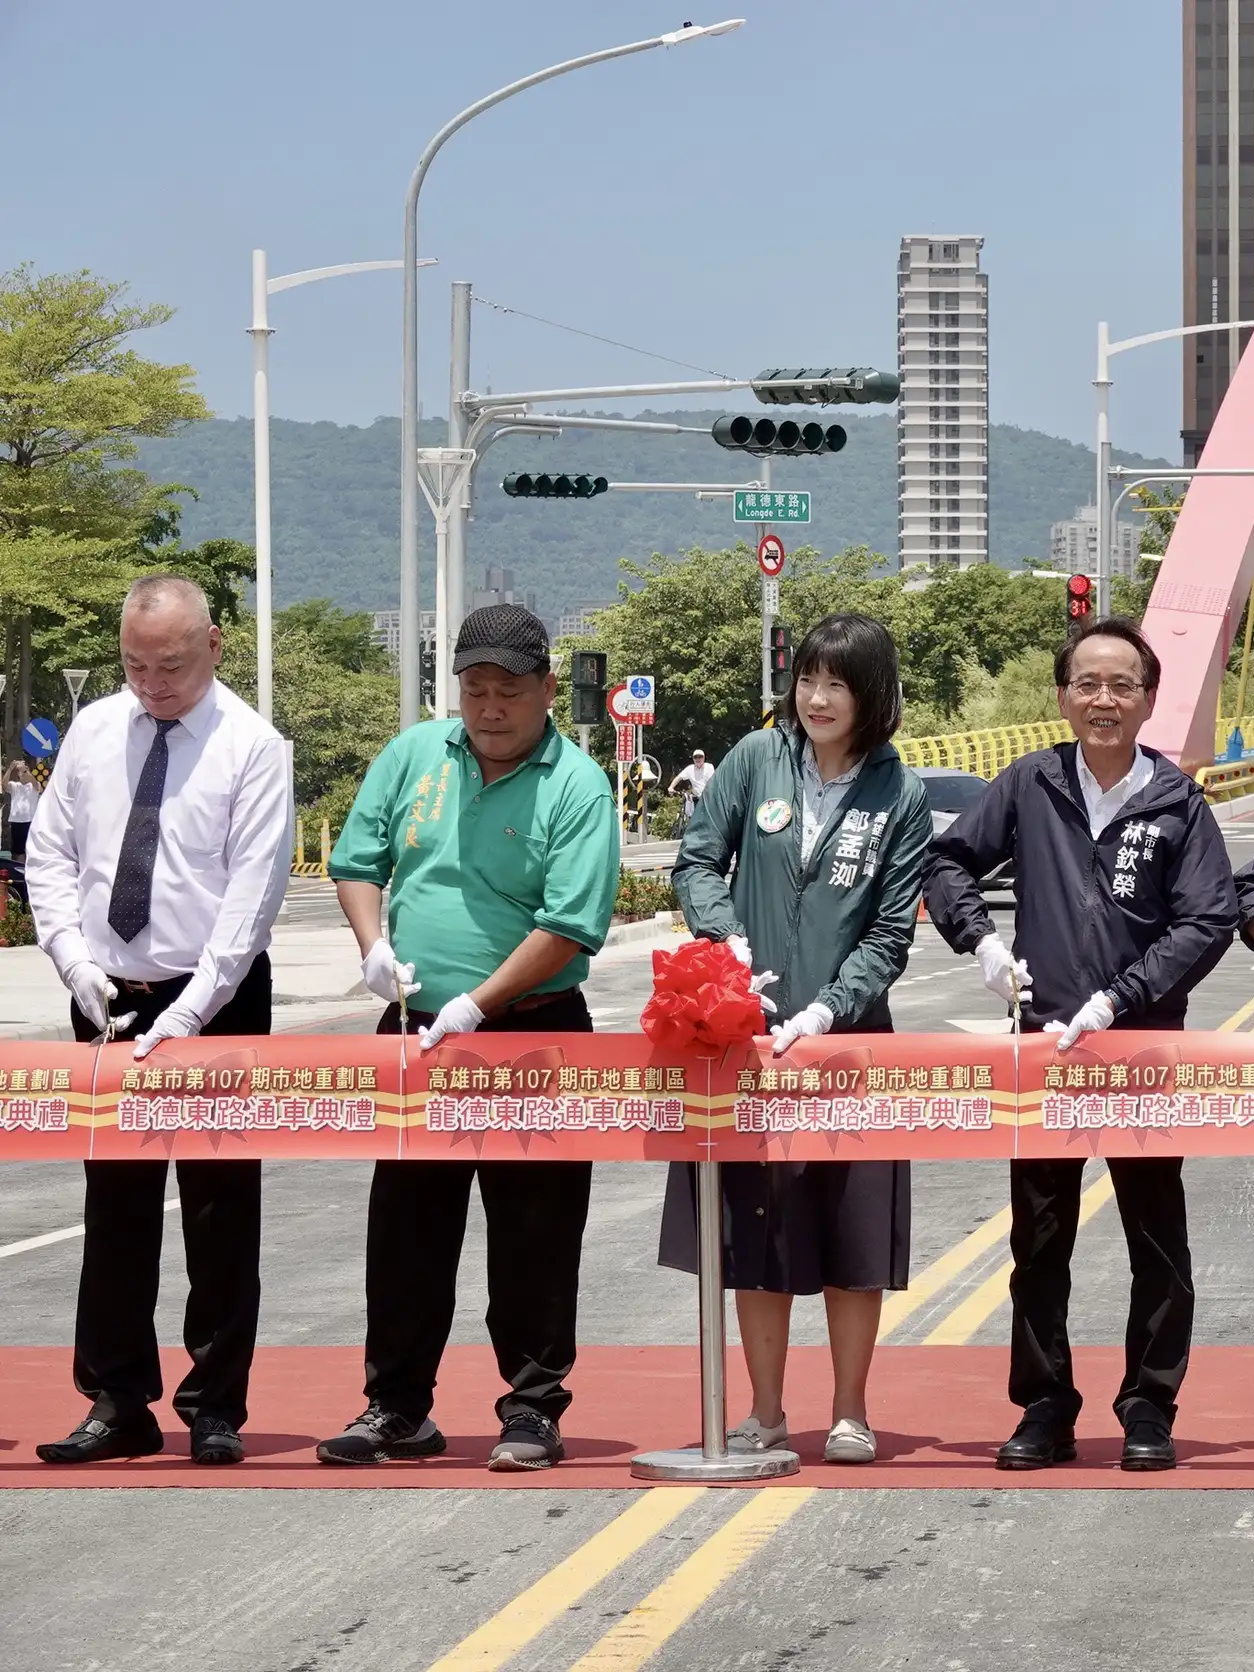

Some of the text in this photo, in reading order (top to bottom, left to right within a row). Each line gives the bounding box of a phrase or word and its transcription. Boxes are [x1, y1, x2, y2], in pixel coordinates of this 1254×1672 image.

[745, 493, 800, 508] 龍德東路
[745, 509, 773, 520] Longde
[1071, 599, 1086, 616] 31
[828, 808, 871, 888] 鄭孟洳
[861, 810, 889, 878] 高雄市議員
[1112, 820, 1146, 898] 林欽榮
[1142, 824, 1161, 861] 副市長
[119, 1096, 376, 1131] 龍德東路通車典禮
[426, 1095, 685, 1132] 龍德東路通車典禮
[734, 1095, 991, 1132] 龍德東路通車典禮
